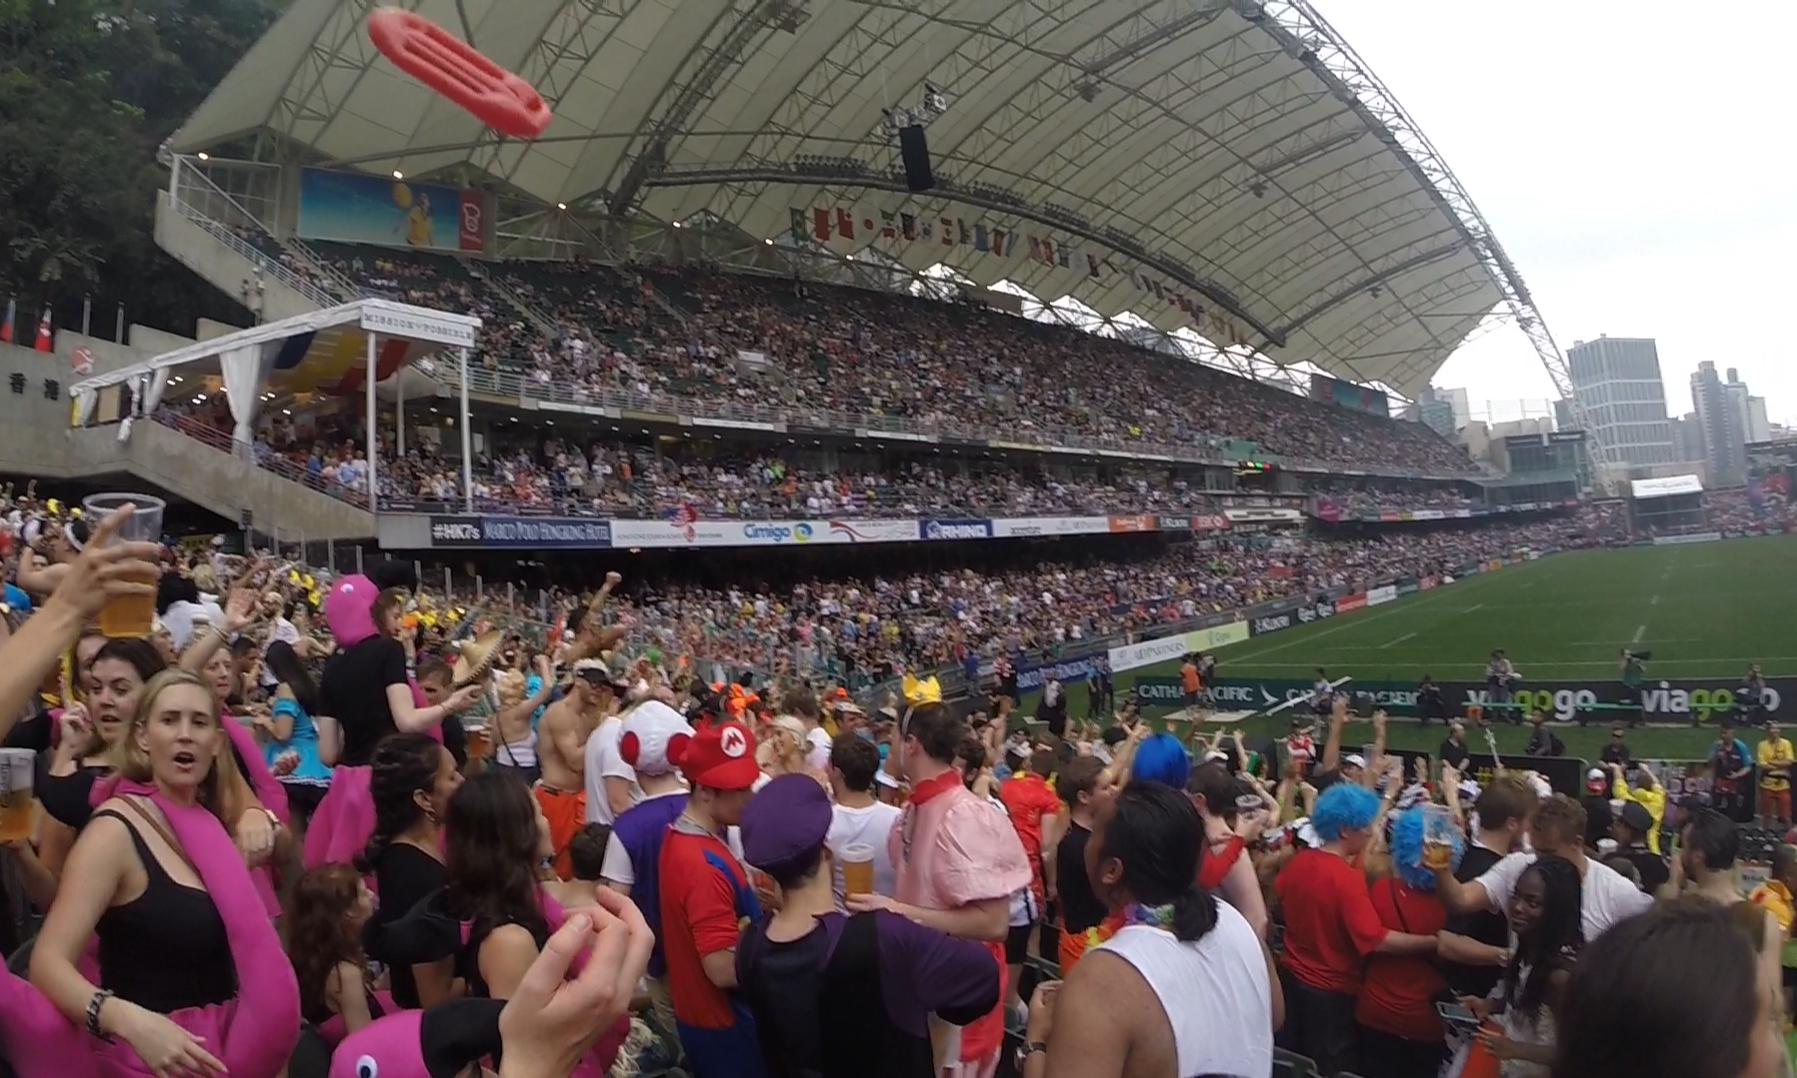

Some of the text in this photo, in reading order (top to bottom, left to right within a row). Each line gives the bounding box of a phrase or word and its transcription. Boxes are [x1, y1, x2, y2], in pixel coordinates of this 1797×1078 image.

[432, 523, 481, 540] #HK7s
[743, 523, 792, 542] Cimigo
[941, 525, 987, 538] RHINO
[1139, 685, 1186, 699] CATHA
[1641, 680, 1781, 721] viagoo
[725, 730, 744, 751] M
